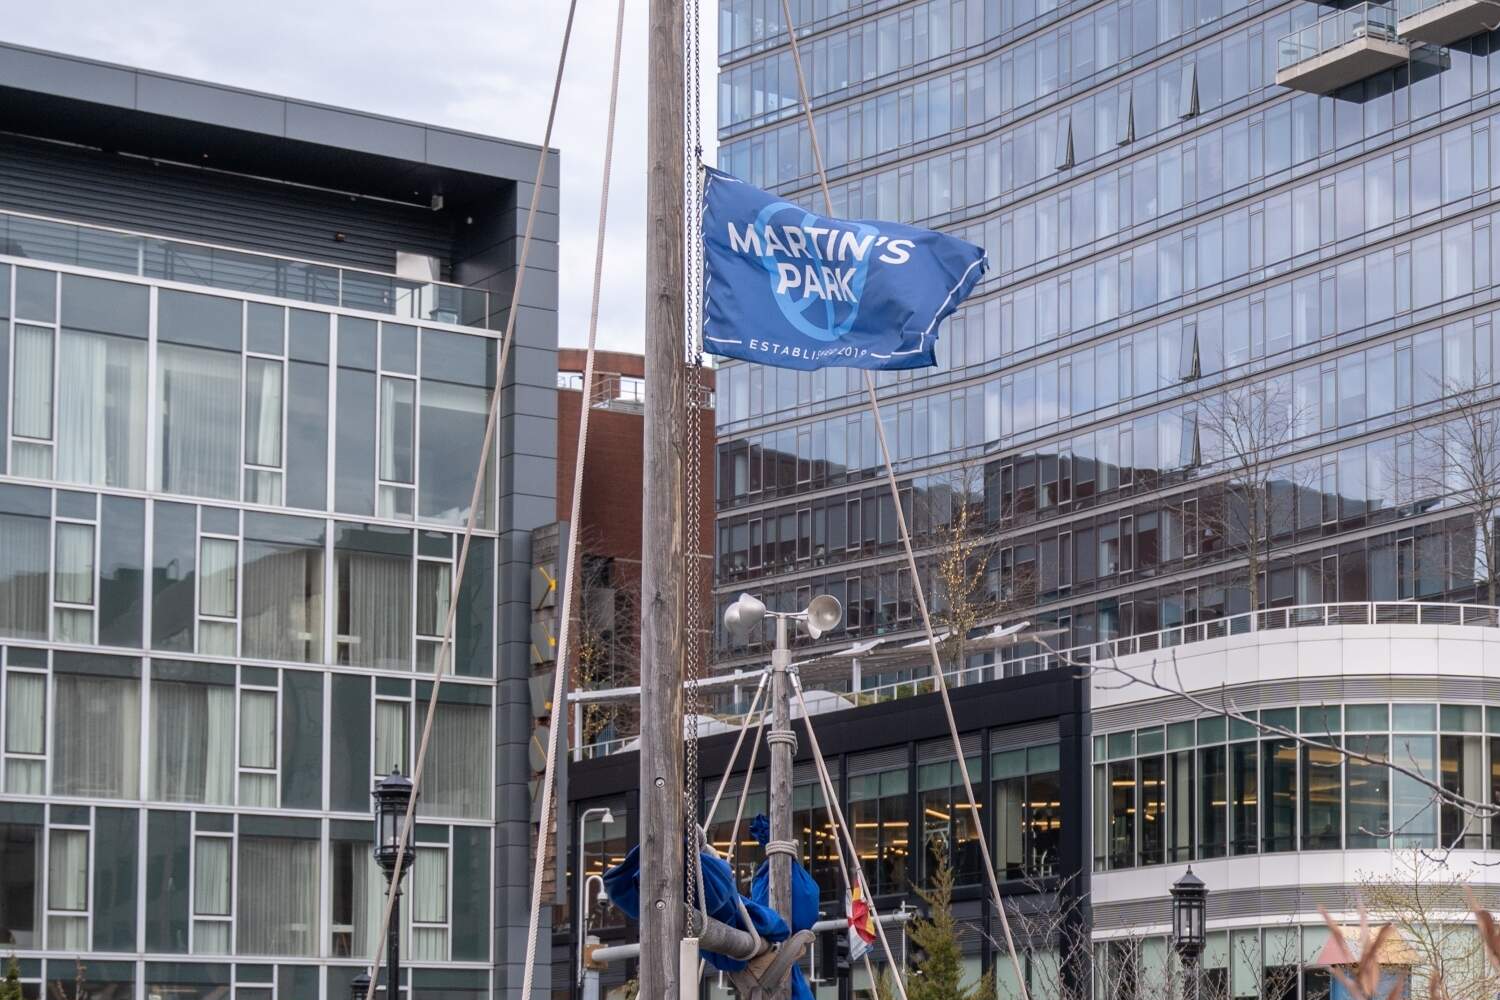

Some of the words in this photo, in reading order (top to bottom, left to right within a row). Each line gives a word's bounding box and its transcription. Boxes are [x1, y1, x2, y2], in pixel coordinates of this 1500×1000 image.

[727, 222, 916, 265] MARTIN'S
[776, 262, 858, 303] PARK
[749, 338, 838, 361] ESTABLIS
